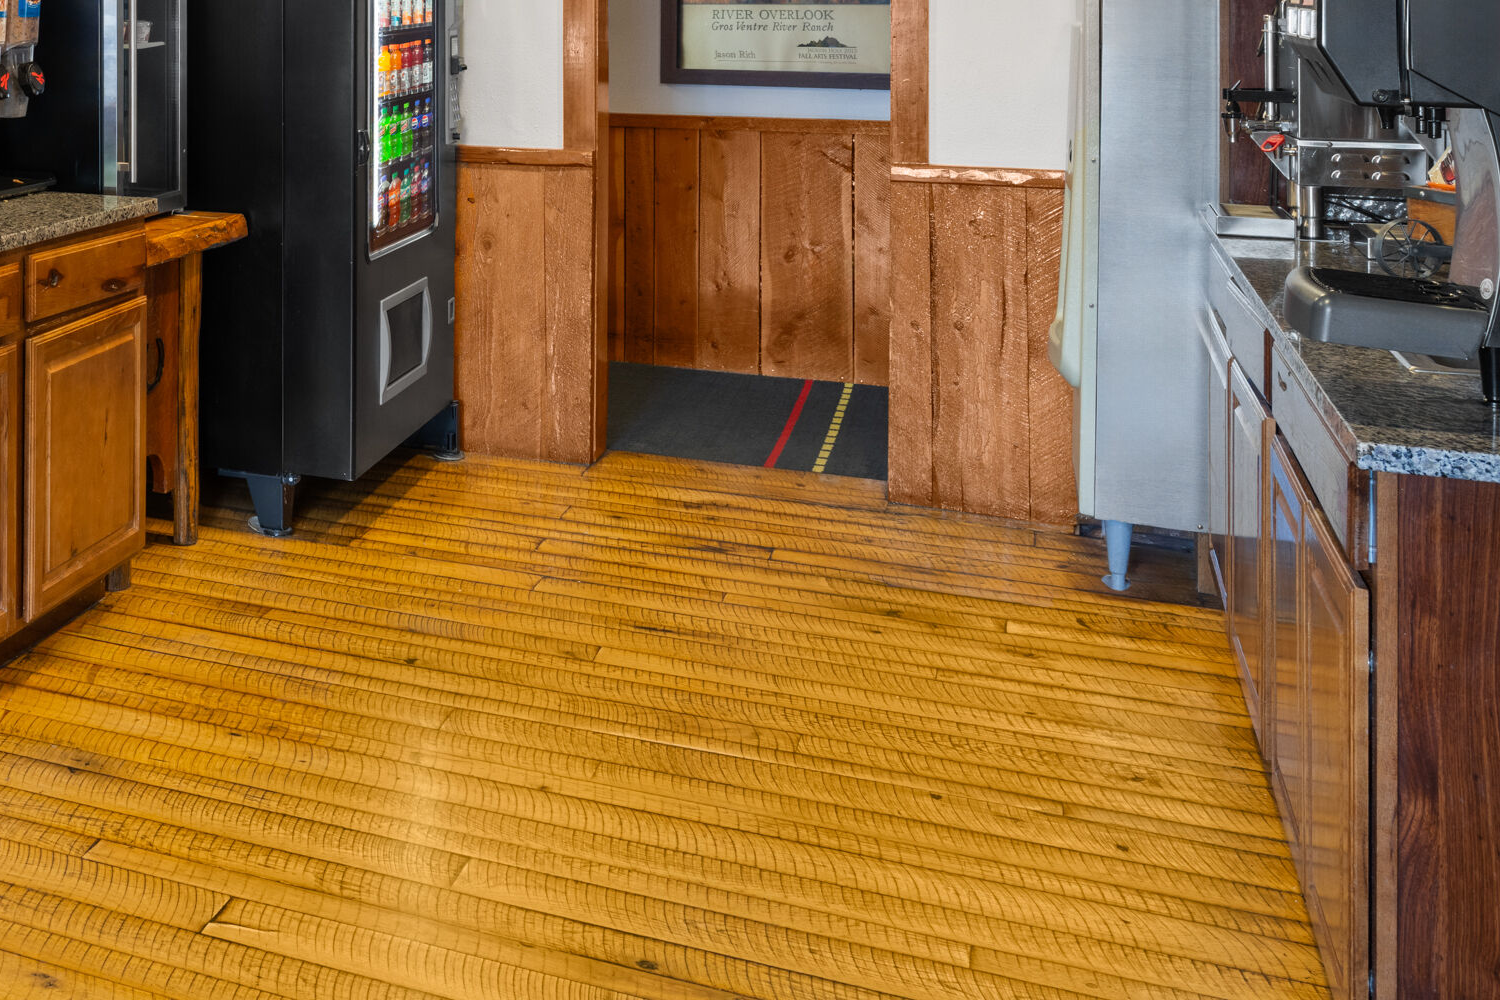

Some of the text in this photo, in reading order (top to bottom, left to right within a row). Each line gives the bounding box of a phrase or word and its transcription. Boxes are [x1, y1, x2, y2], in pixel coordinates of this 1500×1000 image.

[712, 9, 835, 21] RIVER OVERLOOK
[711, 22, 835, 32] Gros Ventre River Ranch
[714, 50, 756, 59] Jason Rich
